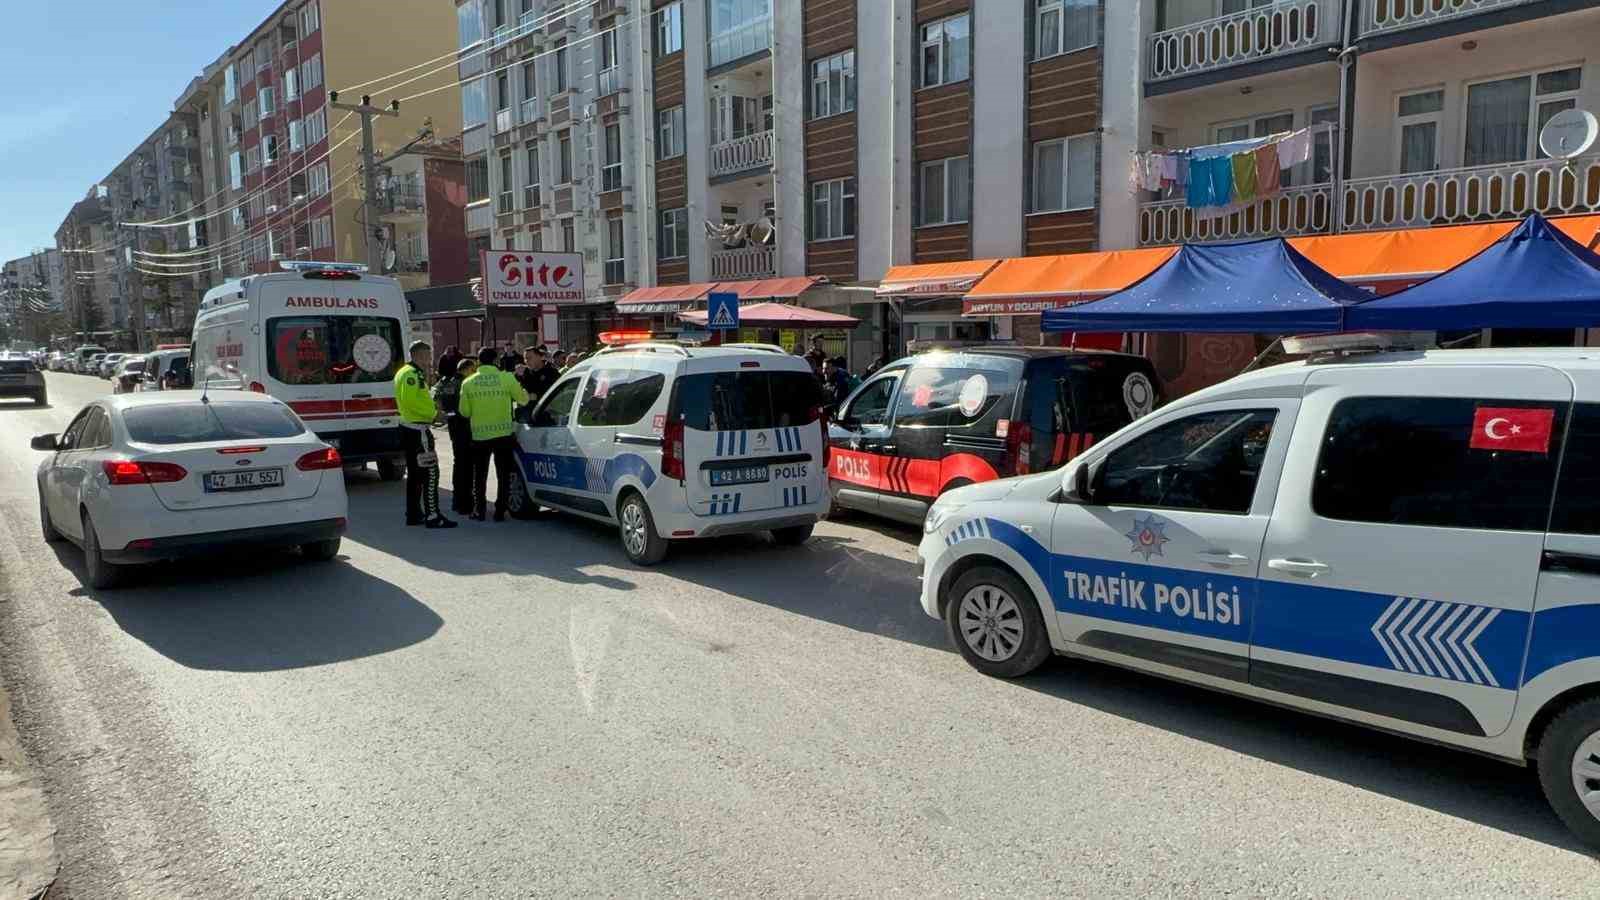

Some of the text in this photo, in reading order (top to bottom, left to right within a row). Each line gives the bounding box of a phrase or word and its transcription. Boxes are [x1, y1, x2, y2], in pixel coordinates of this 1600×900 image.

[498, 254, 574, 288] Site
[286, 296, 378, 309] AMBULANS
[534, 457, 558, 480] POLİS
[775, 464, 808, 479] POLİS
[213, 475, 226, 487] 42
[259, 471, 279, 483] 557
[1063, 571, 1241, 626] TRAFİK POLİSİ
